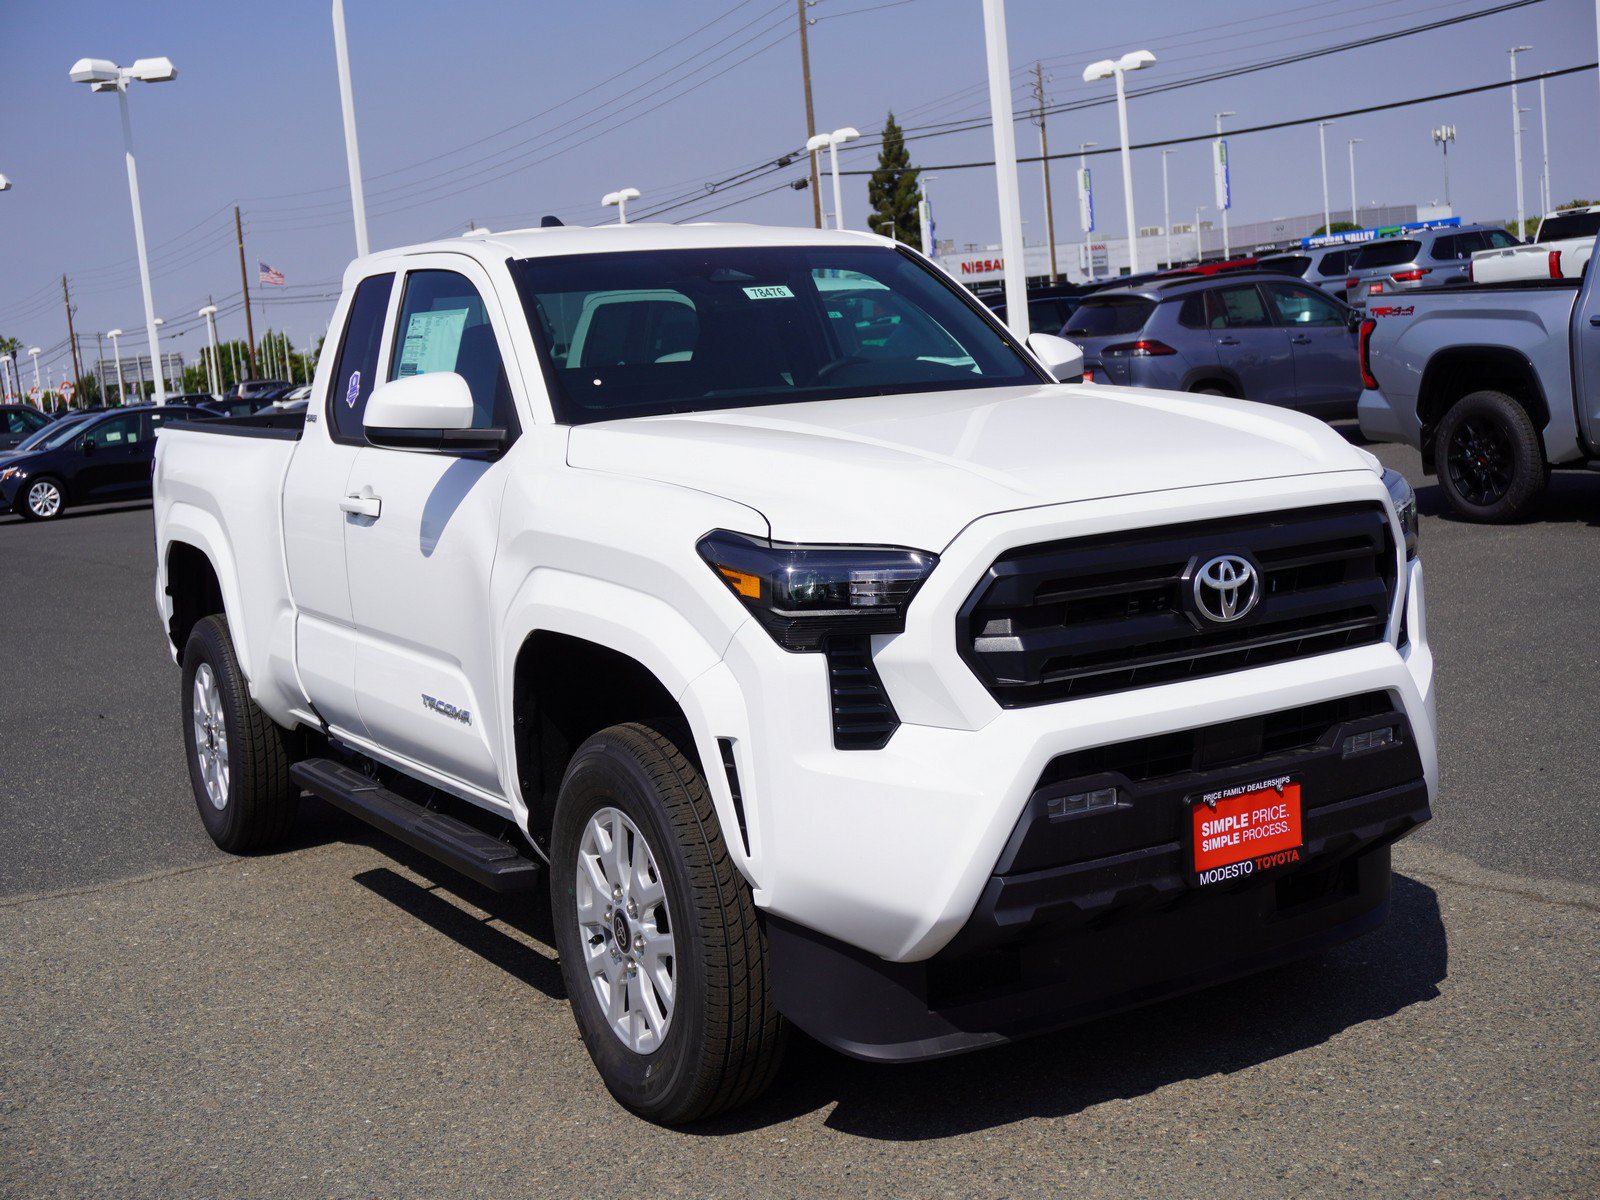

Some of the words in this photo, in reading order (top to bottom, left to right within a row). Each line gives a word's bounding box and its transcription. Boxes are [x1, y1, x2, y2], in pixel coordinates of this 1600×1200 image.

[1345, 230, 1375, 242] VALLEY
[750, 287, 786, 298] 78476
[1203, 791, 1222, 802] PRICE
[1223, 785, 1246, 799] FAMILY
[1247, 776, 1290, 792] DEALERSHIPS
[1201, 812, 1249, 838] SIMPLE
[1252, 803, 1290, 825] PRICE.
[1202, 836, 1240, 852] SIMPLE
[1242, 820, 1291, 842] PROCESS.
[1199, 860, 1253, 886] MODESTO
[1255, 849, 1300, 871] TOYOTA
